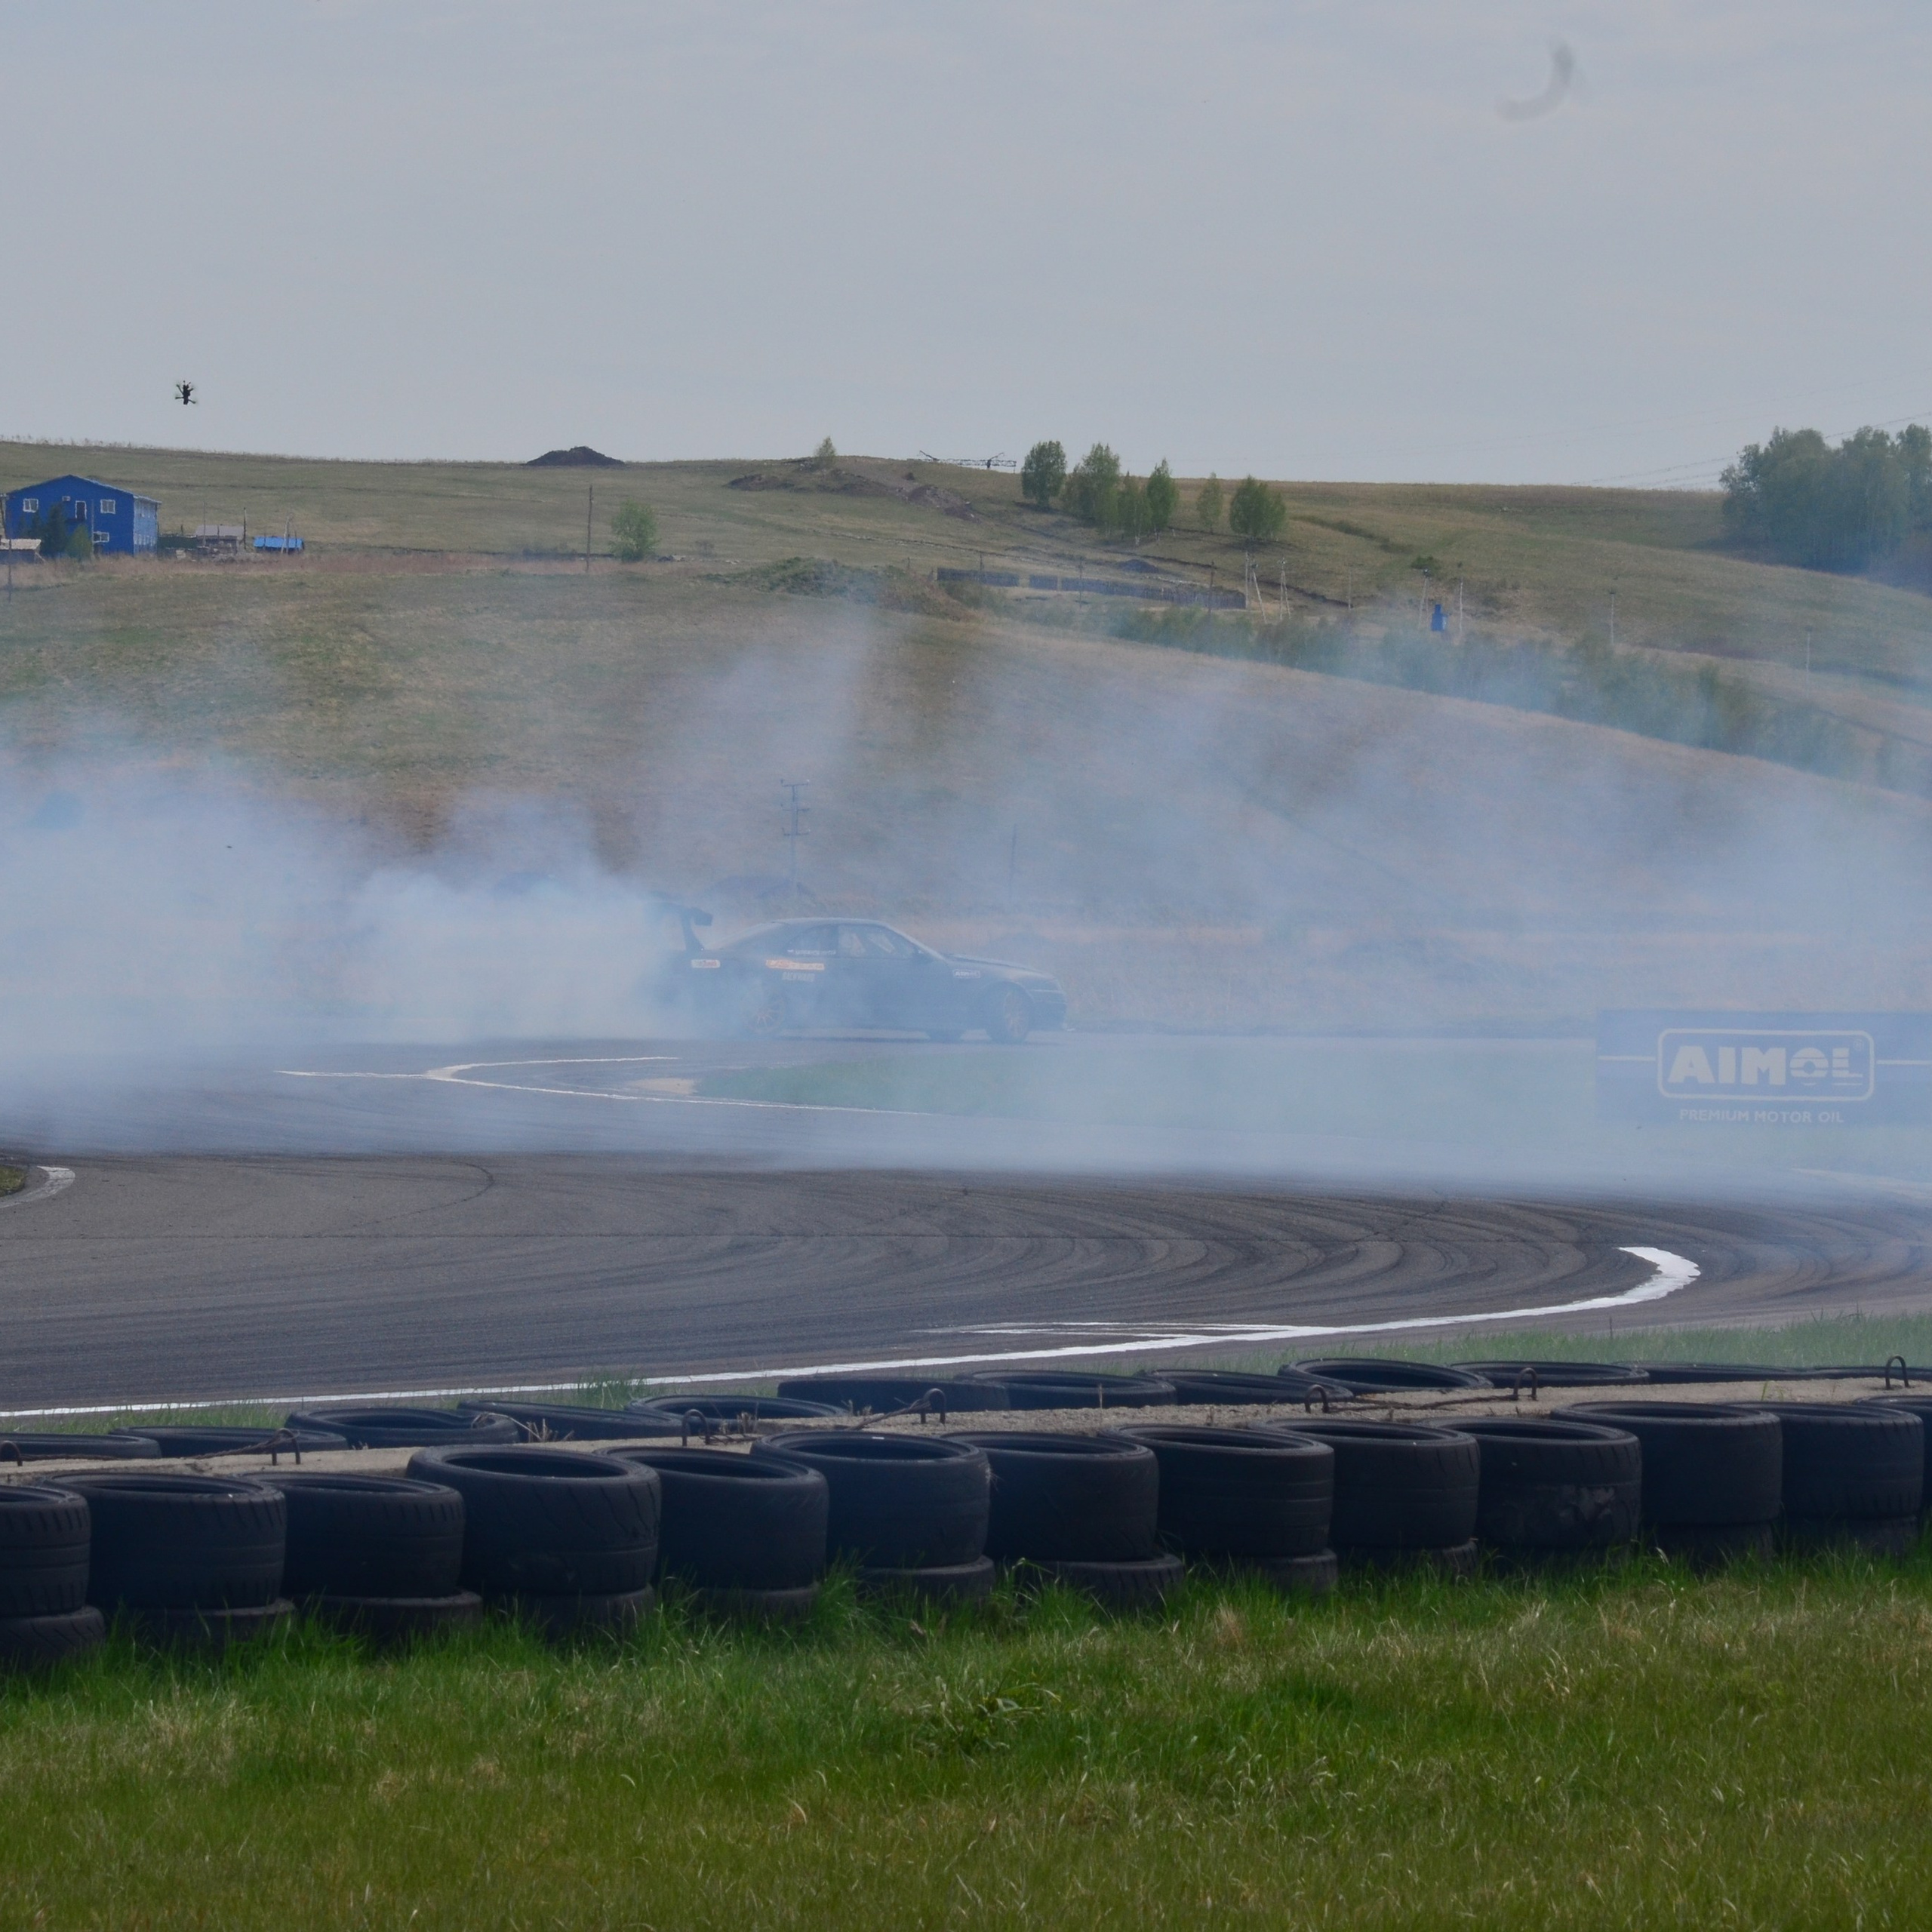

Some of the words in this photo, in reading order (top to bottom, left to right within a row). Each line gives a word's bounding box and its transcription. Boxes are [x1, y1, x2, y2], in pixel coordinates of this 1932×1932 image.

[1667, 1045, 1863, 1085] AIMOL
[1680, 1109, 1749, 1121] PREMIUM
[1755, 1110, 1812, 1123] MOTOR
[1818, 1112, 1844, 1123] OIL
